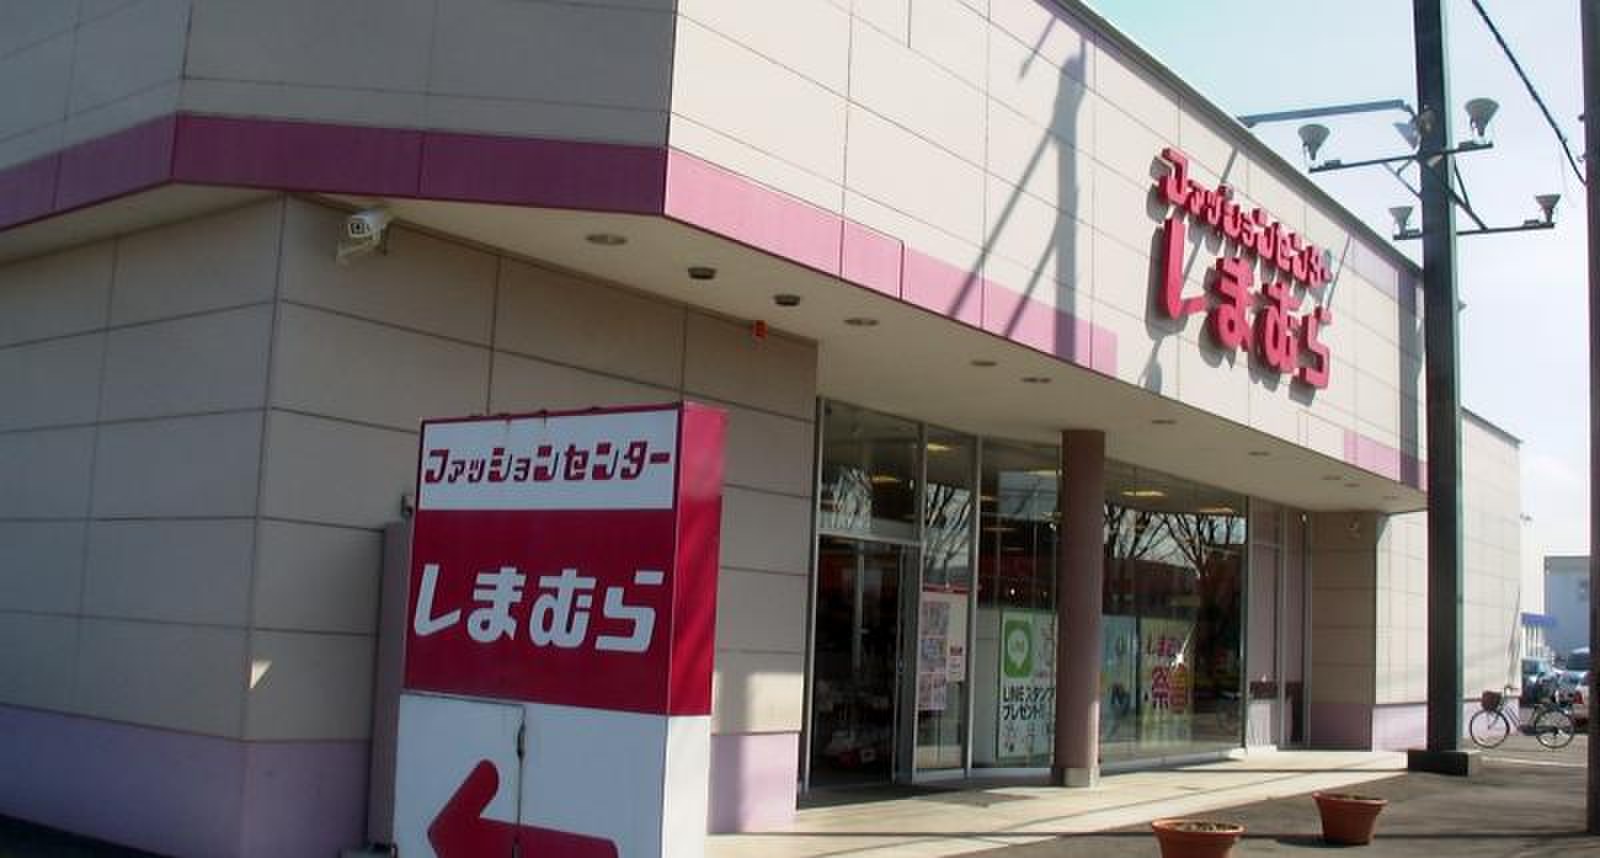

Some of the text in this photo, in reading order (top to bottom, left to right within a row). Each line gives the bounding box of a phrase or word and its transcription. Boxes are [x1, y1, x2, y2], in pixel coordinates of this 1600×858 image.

[1157, 147, 1332, 287] ファッションセンター
[1159, 212, 1332, 389] しまむら
[424, 441, 671, 484] ファッションセンター
[413, 563, 665, 653] しまむら
